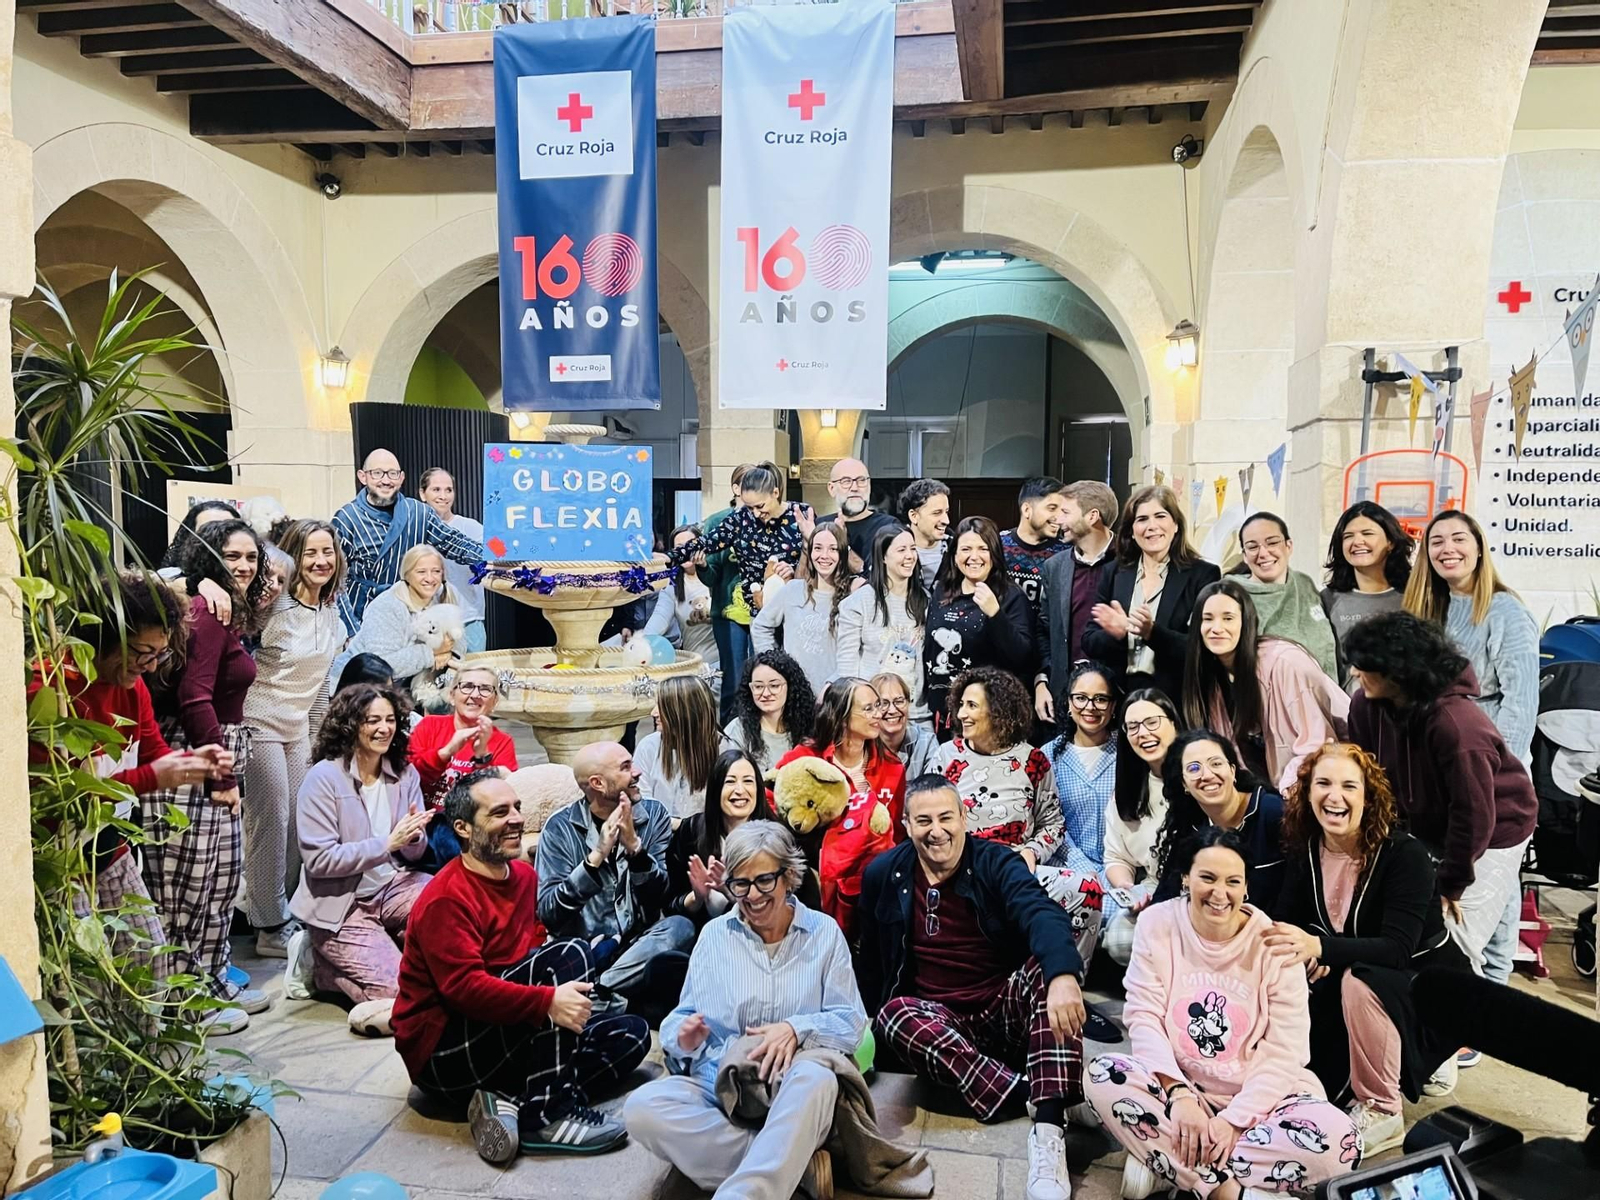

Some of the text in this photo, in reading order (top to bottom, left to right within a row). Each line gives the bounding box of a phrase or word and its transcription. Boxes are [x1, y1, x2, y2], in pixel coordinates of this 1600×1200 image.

[763, 127, 847, 145] Cruz Roja
[536, 138, 615, 156] Cruz Roja
[513, 232, 643, 300] 160
[736, 224, 872, 293] 160
[1554, 287, 1600, 302] Cru
[519, 300, 640, 330] AÑOS
[739, 295, 867, 324] AÑOS
[570, 363, 606, 373] Cruz Roja
[791, 360, 829, 370] Cruz Roja
[512, 468, 632, 494] GLOBO
[1507, 468, 1600, 485] Independe
[1507, 493, 1600, 507] Voluntaria
[1504, 518, 1573, 532] Unidad.
[1181, 972, 1253, 1000] MINNIE
